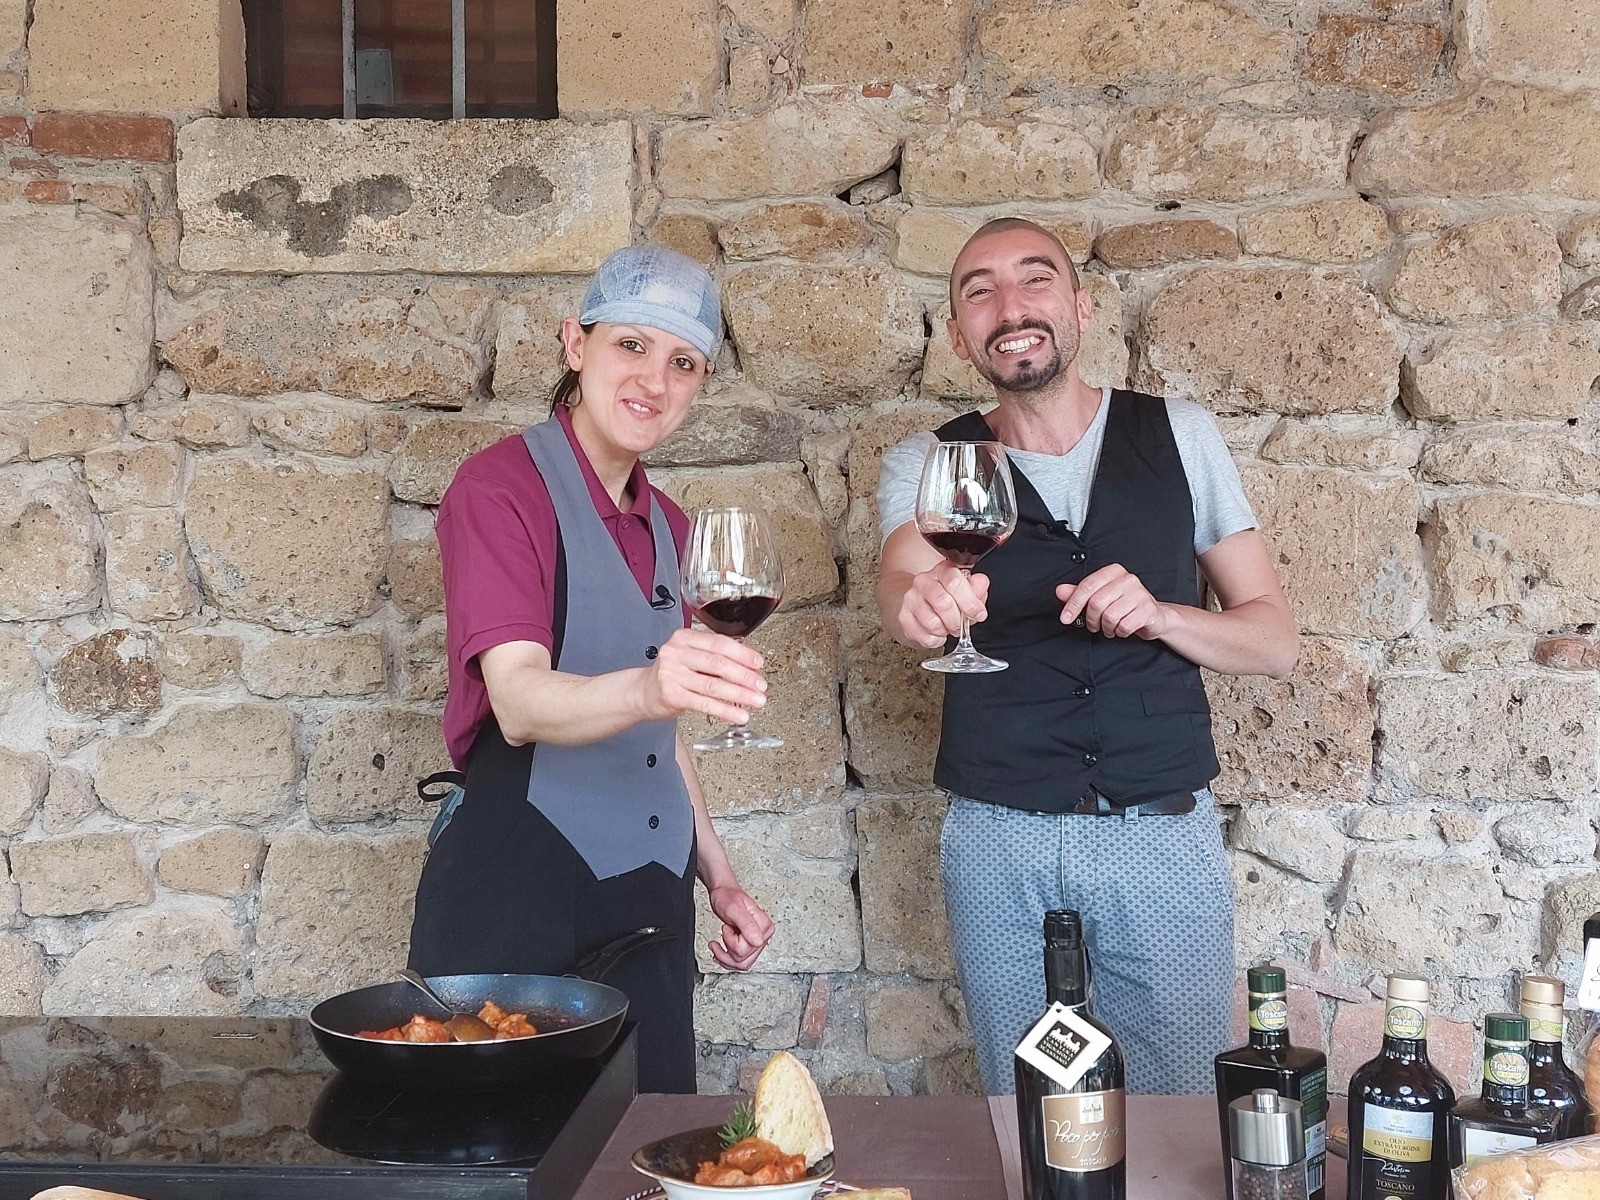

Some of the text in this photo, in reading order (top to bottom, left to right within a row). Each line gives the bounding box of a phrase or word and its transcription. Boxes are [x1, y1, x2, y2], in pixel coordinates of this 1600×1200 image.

[1390, 1015, 1421, 1027] Toscano
[1373, 1139, 1421, 1152] EXTRA VERGINE
[1392, 1149, 1411, 1157] OLIVA
[1376, 1178, 1415, 1191] TOSCANO
